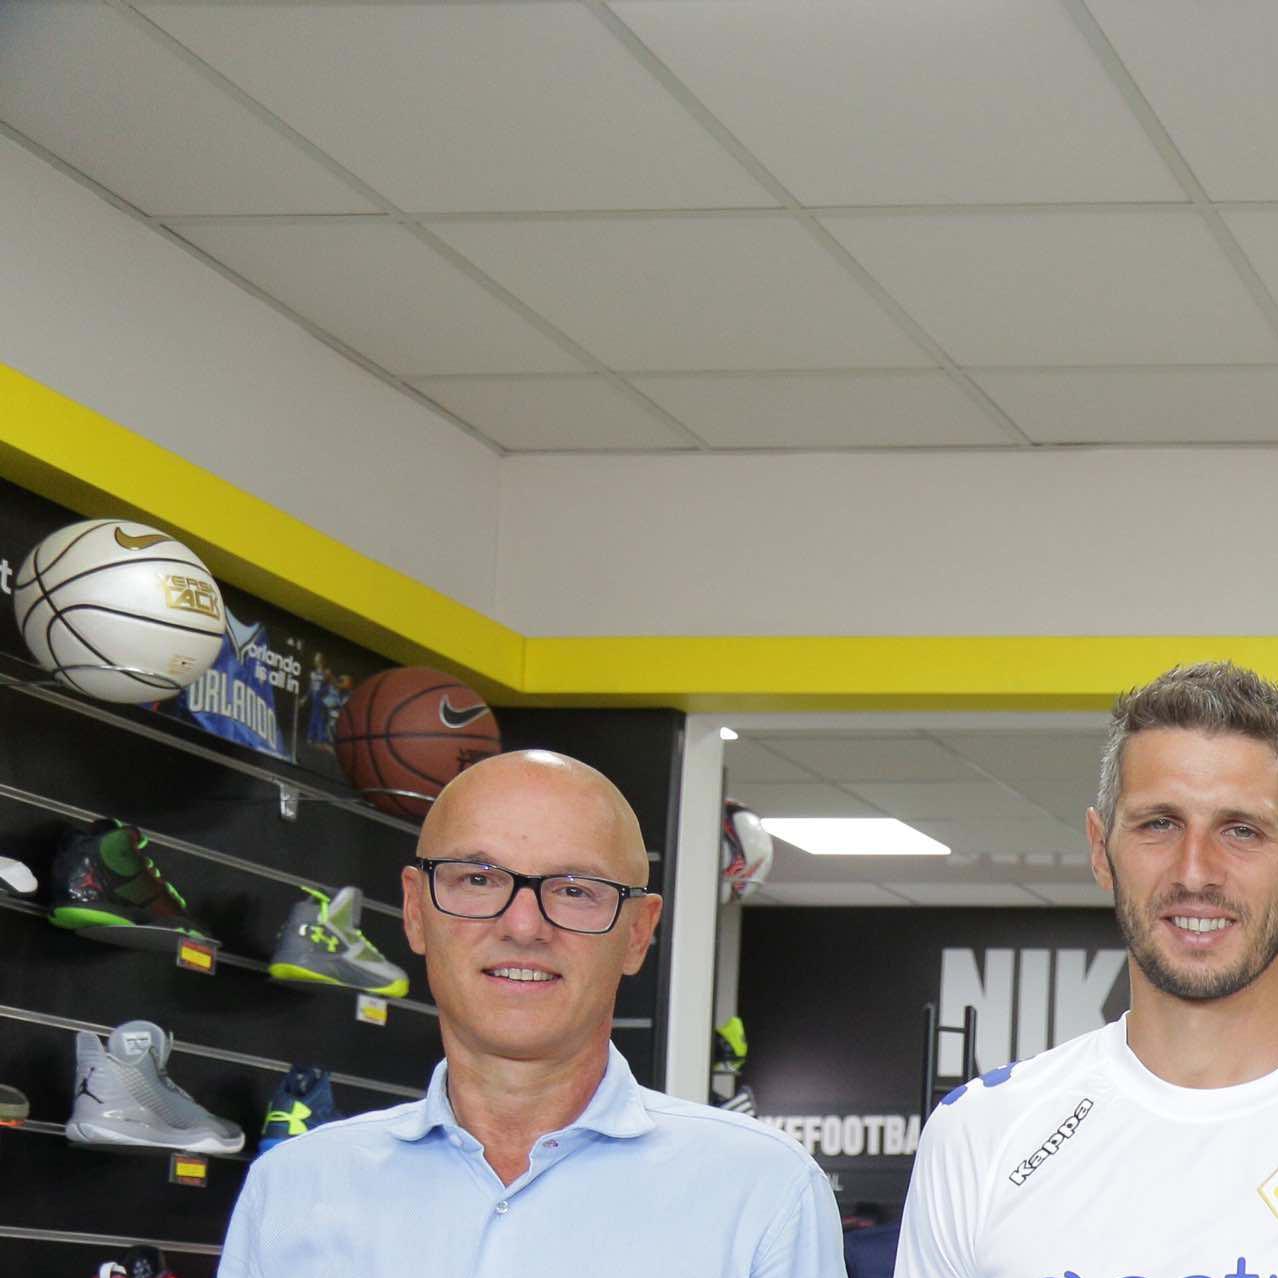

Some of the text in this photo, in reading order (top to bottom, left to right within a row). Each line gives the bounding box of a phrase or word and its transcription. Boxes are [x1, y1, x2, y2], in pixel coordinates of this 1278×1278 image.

[247, 642, 301, 676] orlando
[189, 669, 277, 750] ORLANDO
[1008, 1097, 1094, 1186] Kappa
